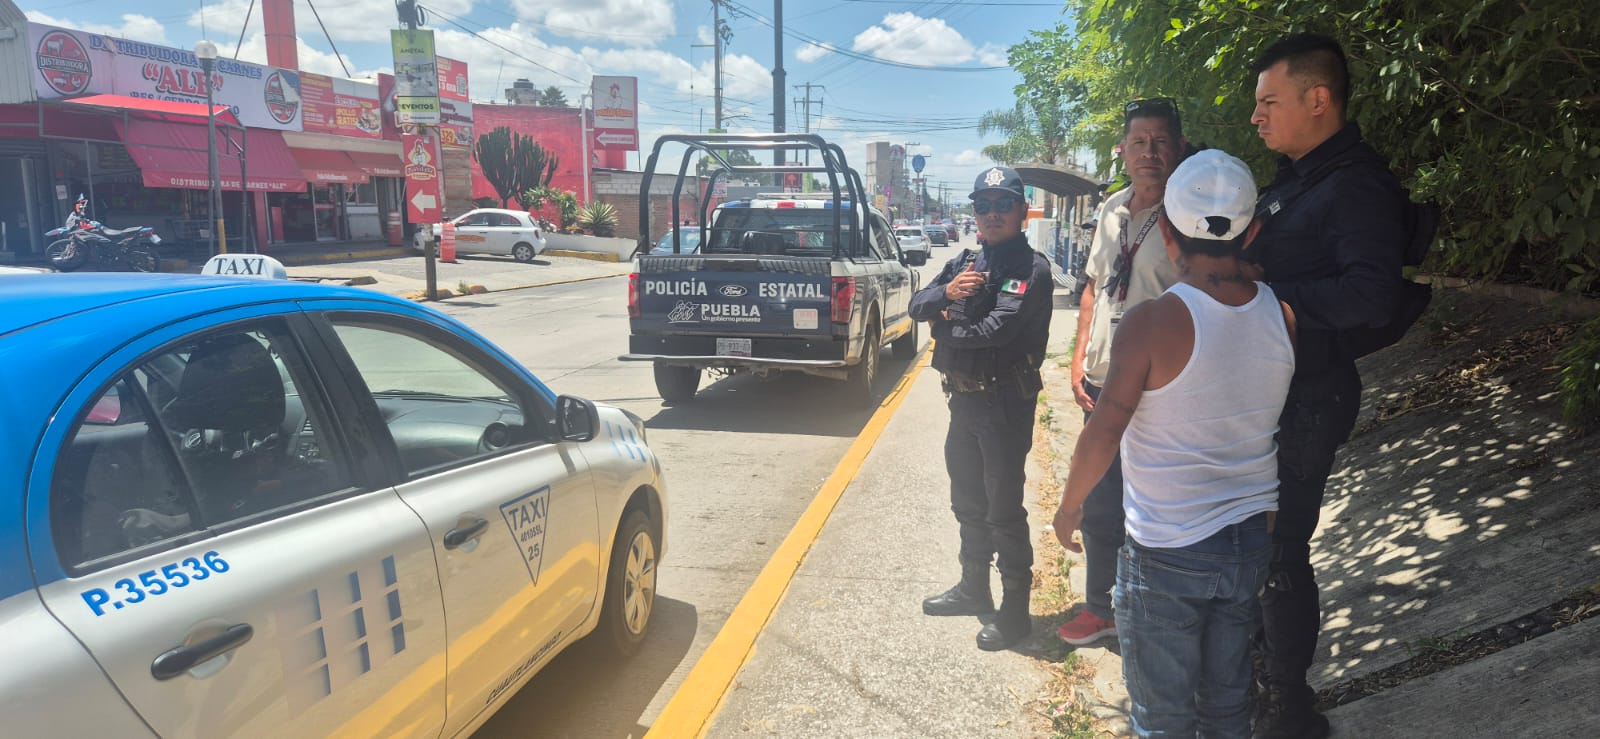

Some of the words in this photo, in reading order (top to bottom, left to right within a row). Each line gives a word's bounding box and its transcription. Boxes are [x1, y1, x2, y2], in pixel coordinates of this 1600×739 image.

[89, 34, 200, 66] DTRIBUIDORA
[217, 60, 262, 79] CARNES
[214, 257, 265, 275] TAXI
[645, 277, 708, 296] POLICÍA
[759, 283, 825, 298] ESTATAL
[722, 286, 743, 296] Ford
[701, 303, 761, 317] PUEBLA
[508, 496, 546, 532] TAXI
[527, 543, 540, 562] 25
[80, 550, 230, 617] P.35536
